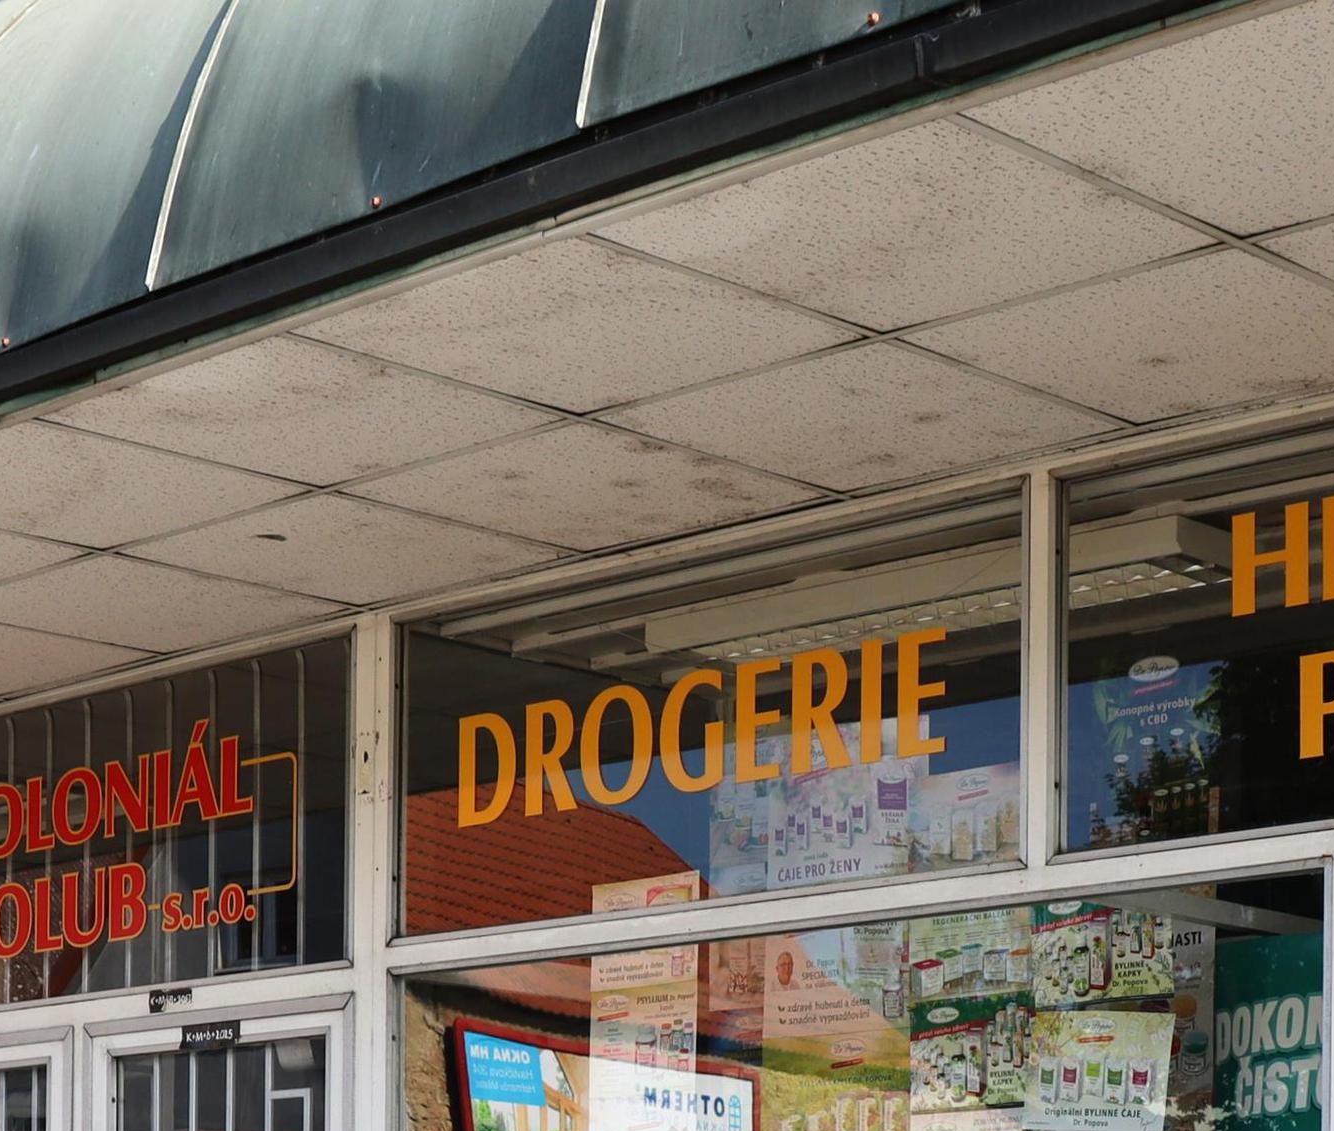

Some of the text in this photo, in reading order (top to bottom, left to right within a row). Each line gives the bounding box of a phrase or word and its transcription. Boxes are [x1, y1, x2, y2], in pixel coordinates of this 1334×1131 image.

[1115, 697, 1196, 718] Konopné výrobky
[1147, 713, 1168, 726] CBD
[458, 627, 946, 827] DROGERIE
[777, 864, 803, 883] ČAJE
[805, 863, 826, 878] PRO
[829, 857, 861, 876] ŽENY
[162, 883, 257, 933] s.r.o.
[1114, 960, 1145, 970] BYLINNÉ
[1117, 970, 1141, 979] KAPKY
[1125, 979, 1148, 988] Popova
[1045, 1106, 1141, 1119] Originální BYLINNÉ ČAJE
[1073, 1119, 1109, 1128] Dr. Popova
